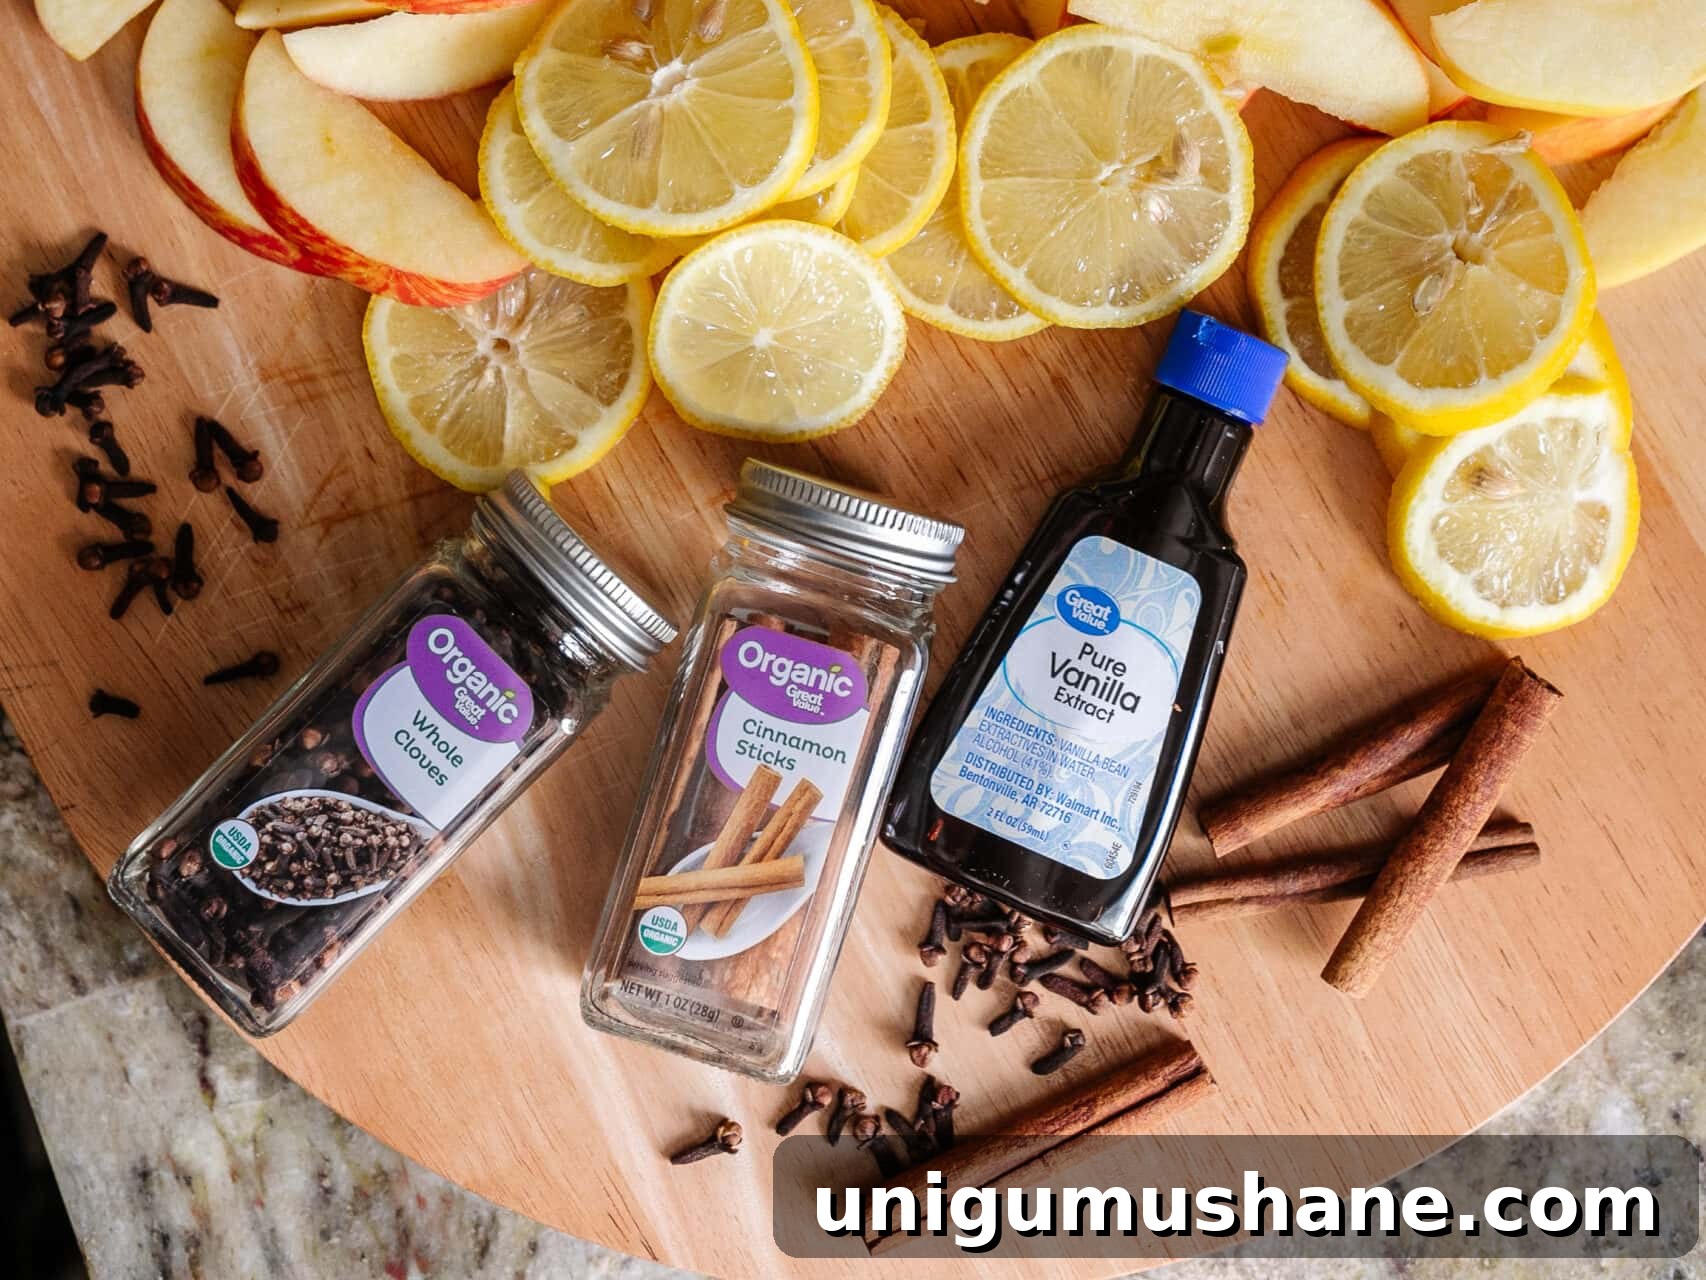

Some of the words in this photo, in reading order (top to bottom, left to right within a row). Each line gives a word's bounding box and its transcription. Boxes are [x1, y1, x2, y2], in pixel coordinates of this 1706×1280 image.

[1065, 589, 1113, 621] Great
[1071, 606, 1107, 630] Value
[427, 628, 519, 725] Organic
[738, 640, 853, 697] Organic
[1077, 641, 1128, 677] Pure
[785, 684, 824, 706] Great
[1049, 651, 1142, 714] Vanilla
[454, 686, 486, 720] Great
[792, 697, 821, 714] Value
[1054, 686, 1115, 723] Extract
[412, 710, 464, 768] Whole
[735, 739, 797, 771] Sticks
[742, 718, 847, 764] Cinnamon
[972, 733, 1020, 763] ALCOHOL
[978, 720, 1044, 758] EXTRACTIVES
[1043, 746, 1057, 763] IN
[984, 706, 1058, 746] INGREDIENTS:
[1060, 738, 1101, 766] VANILLA
[1100, 755, 1129, 779] BEAN
[958, 766, 1018, 802] Bentonville,
[1020, 795, 1038, 810] AR
[1038, 801, 1072, 824] 72716
[964, 751, 1034, 791] DISTRIBUTED
[1035, 782, 1054, 800] BY:
[1056, 792, 1100, 821] Walmart
[1100, 809, 1121, 832] Inc.,
[227, 826, 252, 852] USDA
[986, 807, 993, 818] 2
[993, 809, 1005, 822] FL
[1005, 814, 1018, 827] OZ
[1017, 819, 1050, 842] (59mL)
[643, 928, 679, 947] ORGANIC
[651, 915, 679, 933] USDA
[620, 980, 643, 997] NET
[644, 986, 662, 1003] WT
[665, 993, 670, 1006] 1
[673, 996, 690, 1011] OZ
[690, 1001, 721, 1023] (28g)
